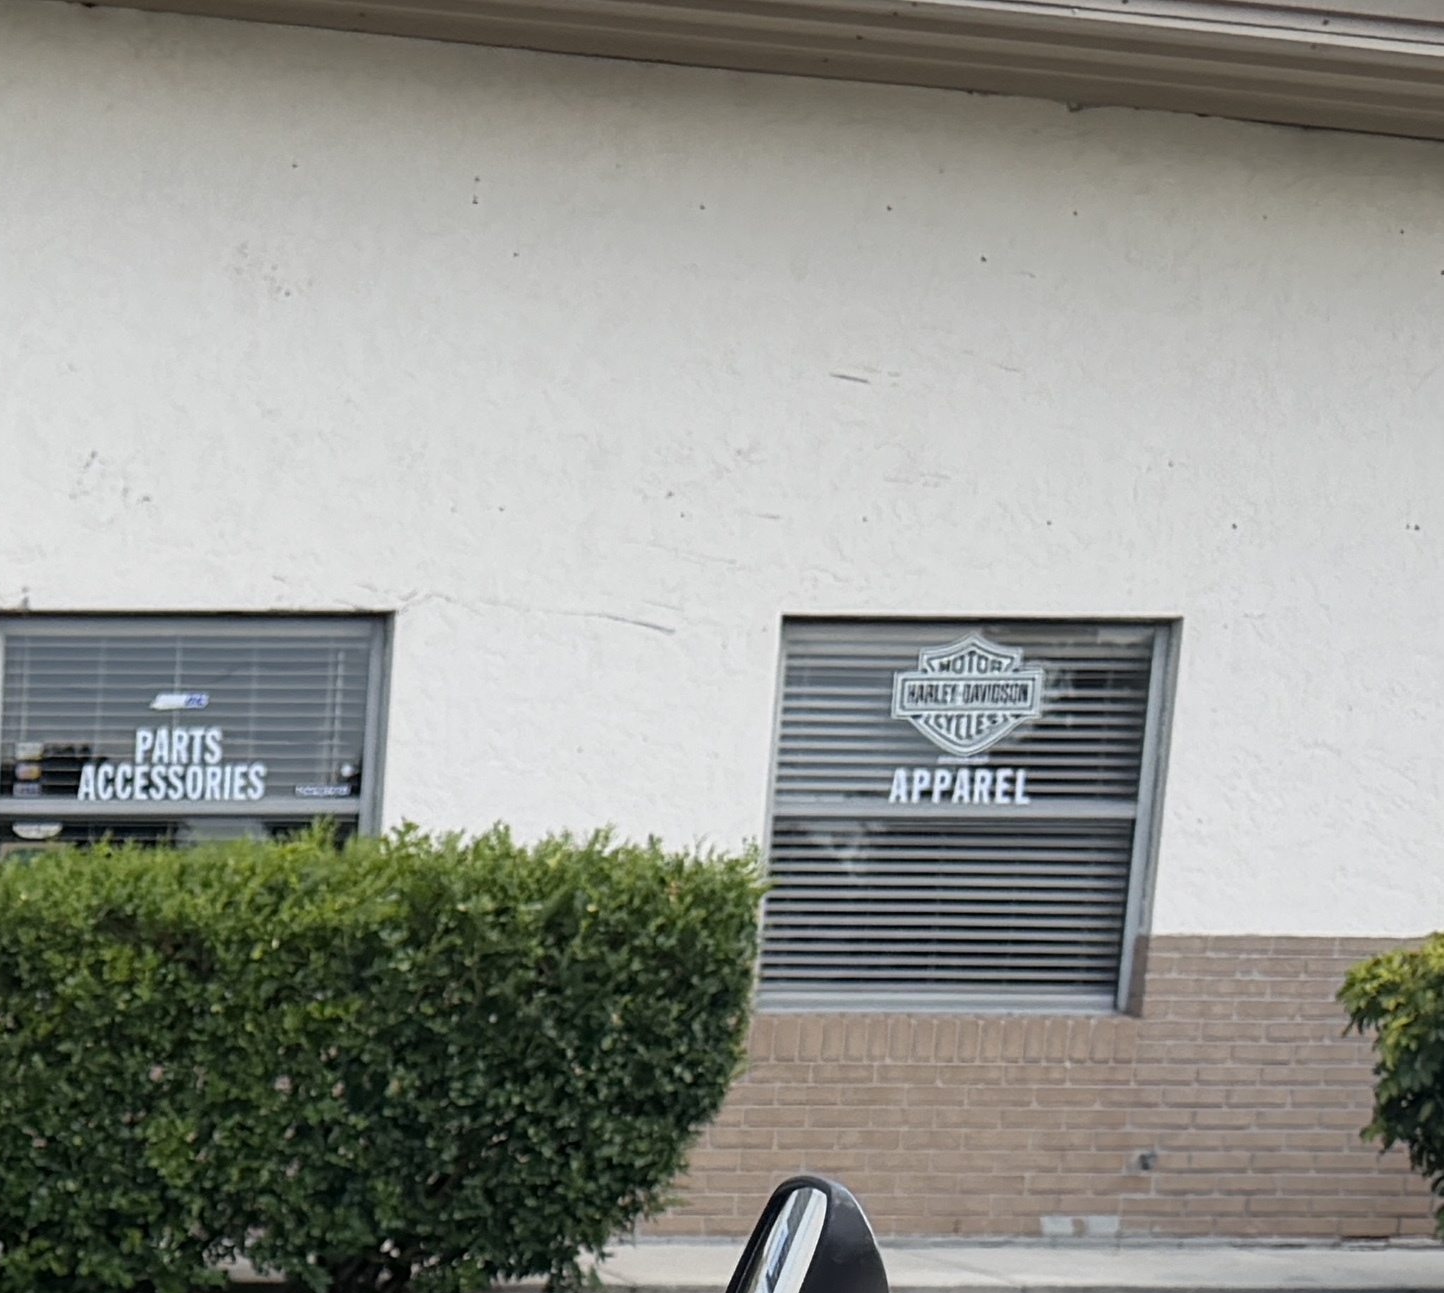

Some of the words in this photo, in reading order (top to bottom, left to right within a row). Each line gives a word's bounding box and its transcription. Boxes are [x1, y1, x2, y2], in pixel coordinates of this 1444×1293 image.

[939, 650, 1002, 674] MOTOR
[135, 726, 223, 764] PARTS
[933, 713, 1000, 740] CYCLES
[78, 762, 267, 801] ACCESSORIES
[889, 767, 1030, 805] APPAREL
